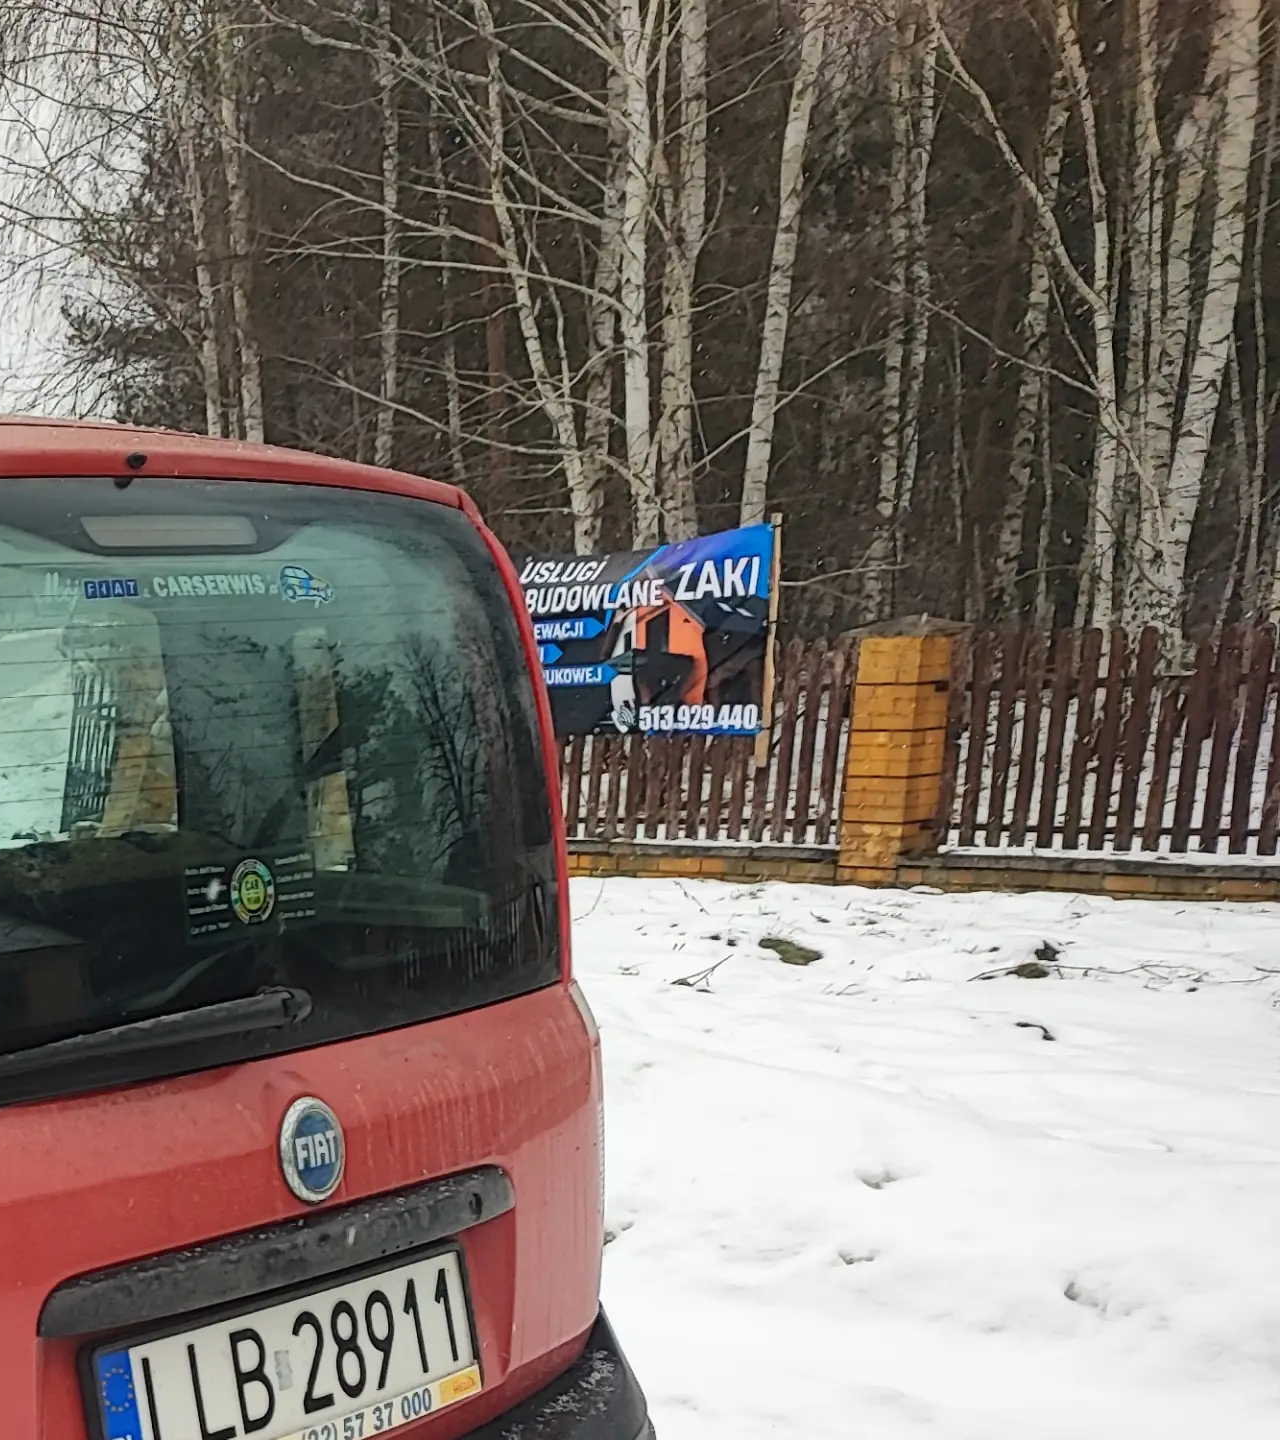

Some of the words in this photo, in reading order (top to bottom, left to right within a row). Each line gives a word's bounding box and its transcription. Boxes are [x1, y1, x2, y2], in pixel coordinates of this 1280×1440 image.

[85, 578, 138, 599] FIAT
[519, 560, 608, 585] USŁUGI
[674, 555, 761, 601] ZAKI
[524, 578, 665, 614] BUDOWLANE
[543, 667, 602, 686] UKOWEJ
[294, 1129, 337, 1170] FIAT
[292, 1267, 460, 1415] 28911
[373, 1401, 395, 1432] 37
[401, 1387, 433, 1420] 000
